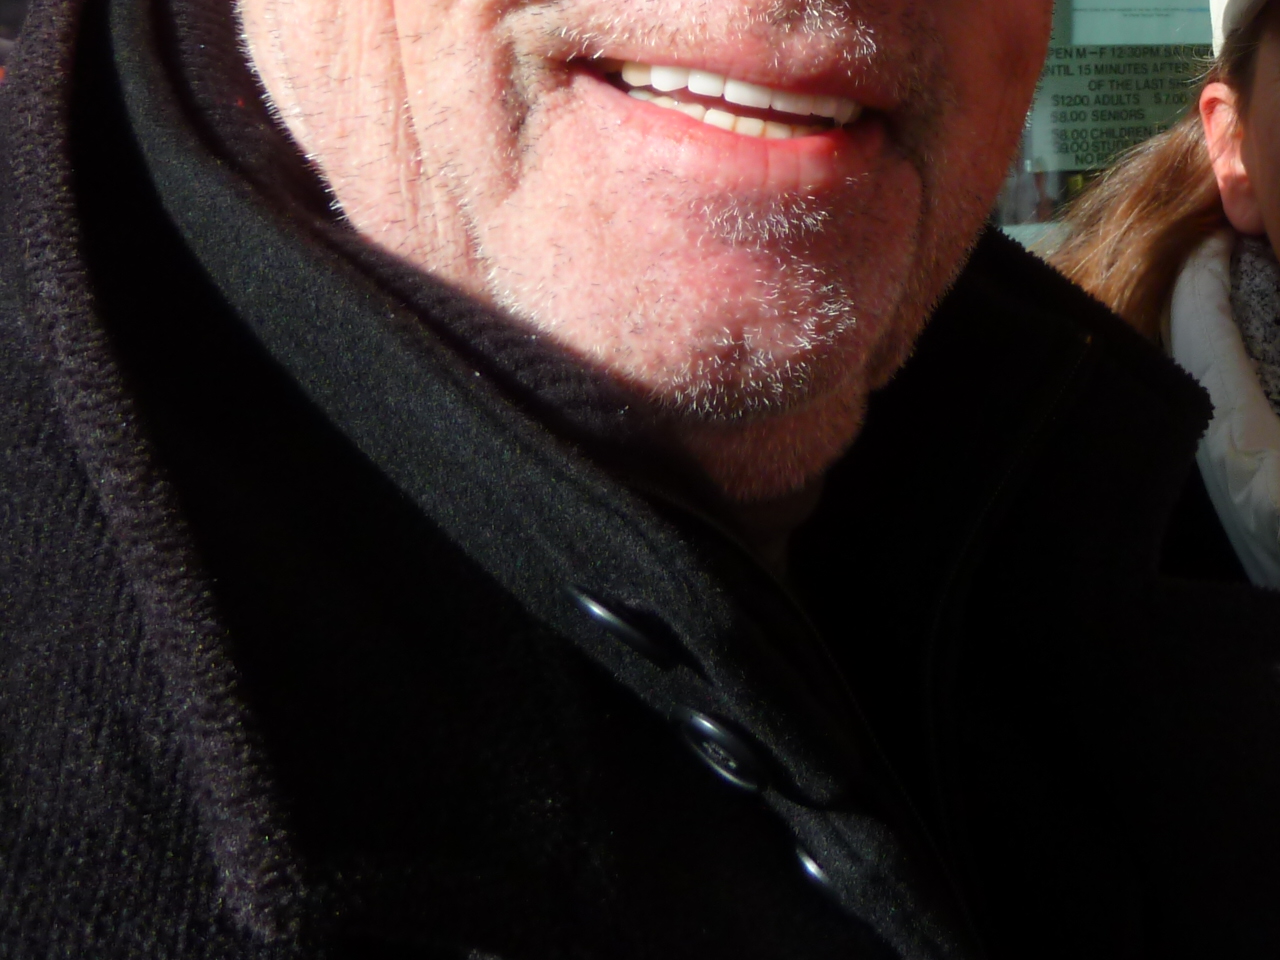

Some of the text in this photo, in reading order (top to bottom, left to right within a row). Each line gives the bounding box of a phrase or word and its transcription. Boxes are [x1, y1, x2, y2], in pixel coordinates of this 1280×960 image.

[1048, 46, 1073, 59] PEN
[1047, 63, 1075, 76] NTIL
[1078, 63, 1091, 76] 15
[1094, 62, 1147, 75] MINUTES
[1152, 61, 1190, 74] AFTER
[1088, 79, 1104, 91] OF
[1108, 78, 1132, 91] THE
[1135, 78, 1163, 90] LAST
[1094, 93, 1140, 106] ADULTS
[1091, 108, 1144, 122] SENIORS
[1090, 126, 1152, 140] CHILDREN
[1074, 152, 1094, 165] NO
